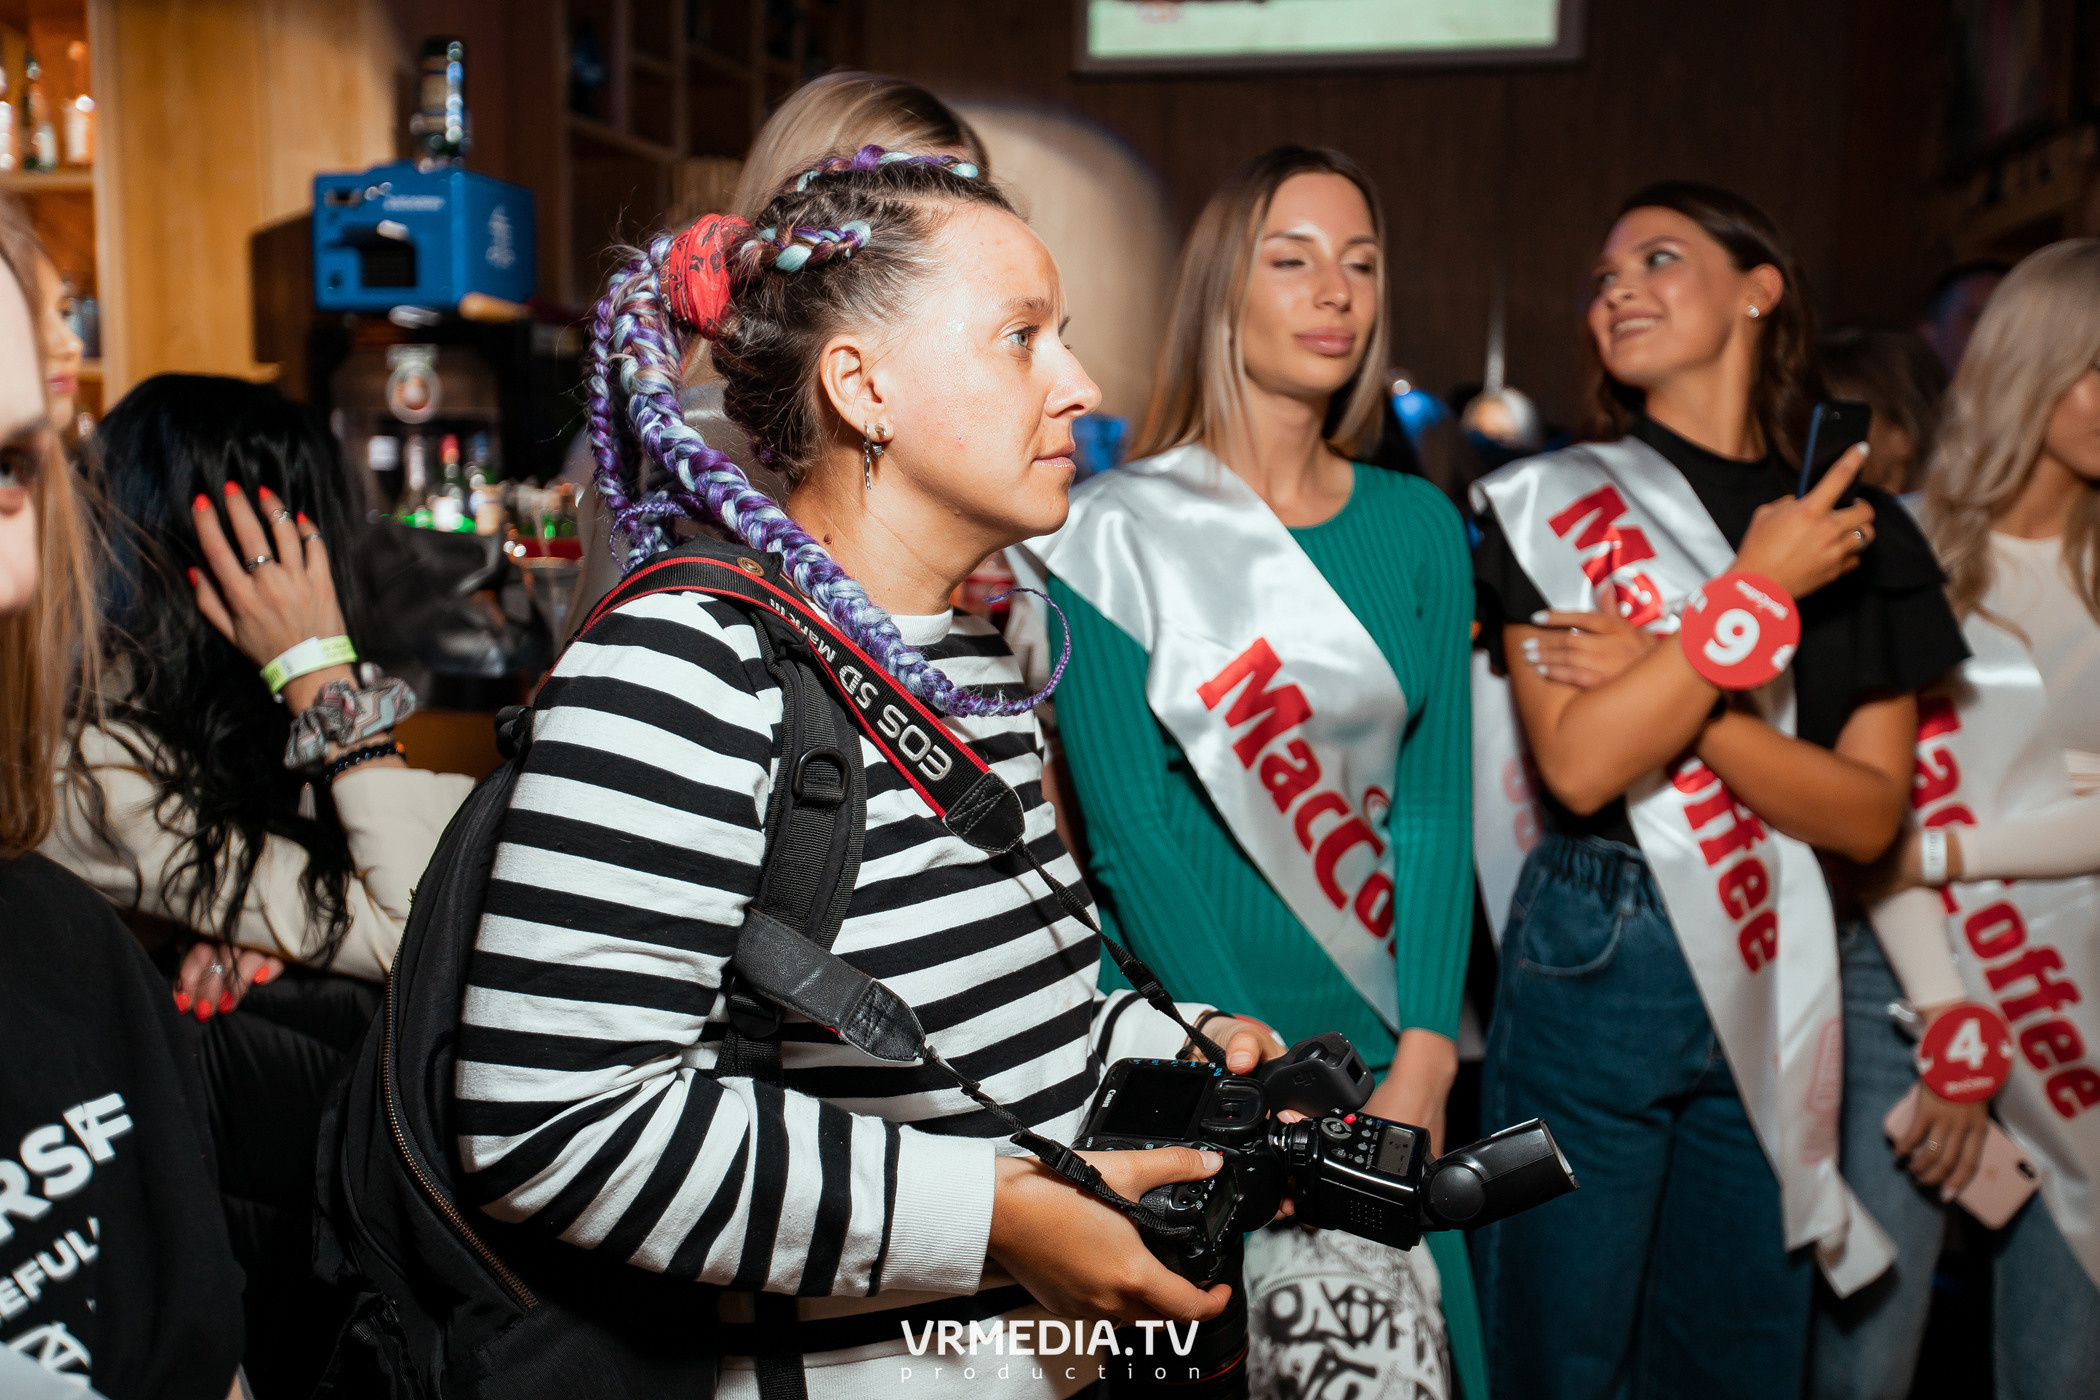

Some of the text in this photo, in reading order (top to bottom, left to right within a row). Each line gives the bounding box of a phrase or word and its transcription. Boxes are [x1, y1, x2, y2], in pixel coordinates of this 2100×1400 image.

[839, 665, 879, 710] 5D
[877, 704, 953, 781] EOS
[1196, 637, 1396, 960] MacCo
[1945, 1017, 1989, 1071] 4
